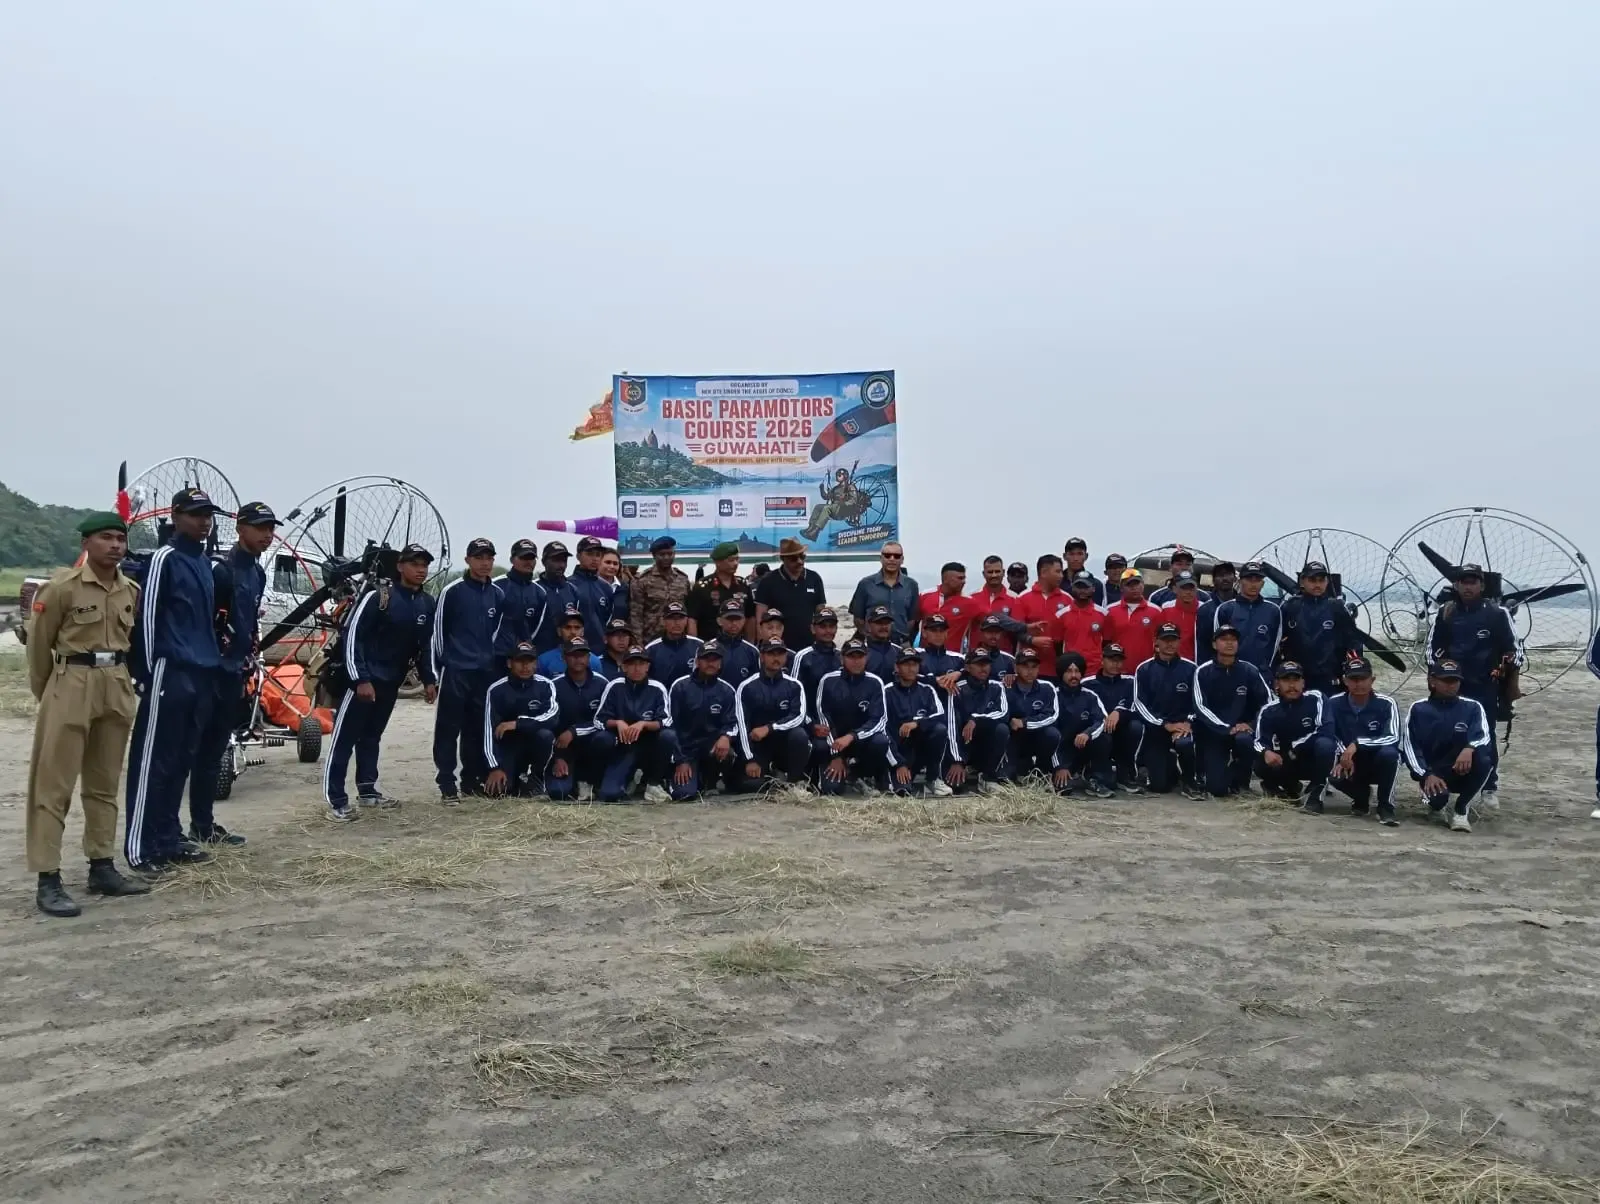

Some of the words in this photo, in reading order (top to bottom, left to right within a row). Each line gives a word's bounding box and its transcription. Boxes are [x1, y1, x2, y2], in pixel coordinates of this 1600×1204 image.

[662, 400, 713, 419] BASIC
[719, 397, 834, 419] PARAMOTORS
[685, 421, 758, 439] COURSE
[765, 419, 812, 438] 2026
[704, 441, 795, 455] GUWAHATI
[838, 536, 858, 545] LEADER
